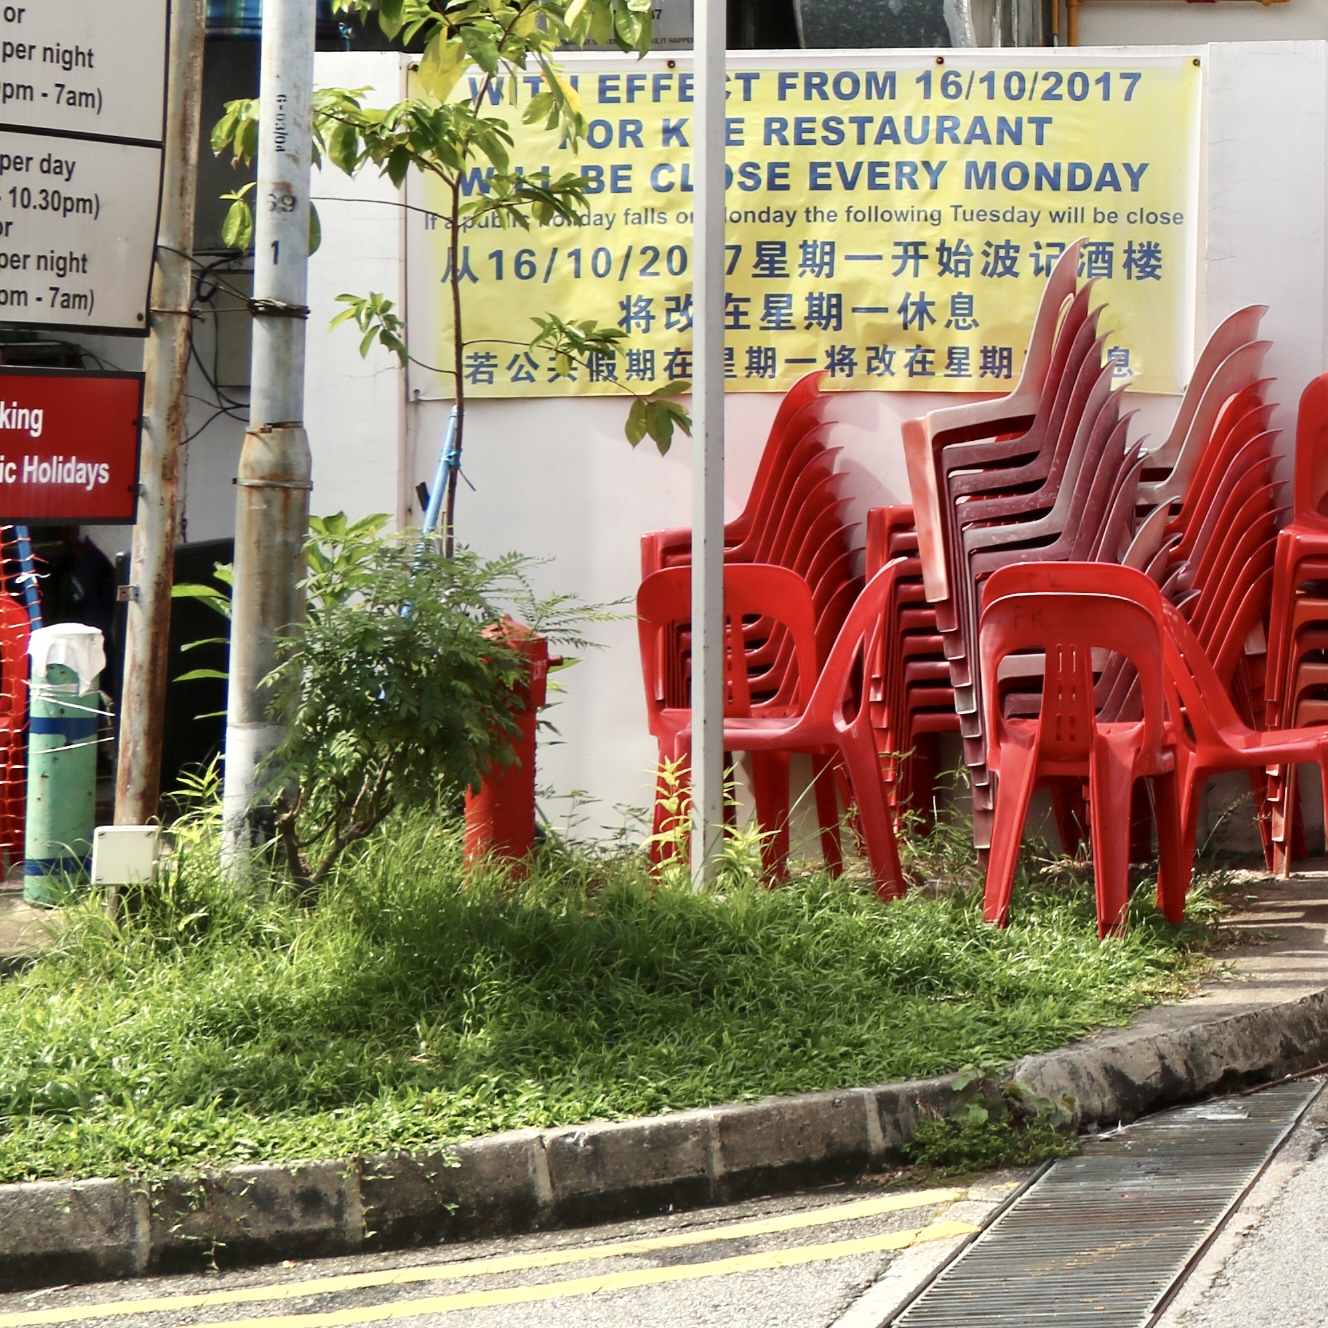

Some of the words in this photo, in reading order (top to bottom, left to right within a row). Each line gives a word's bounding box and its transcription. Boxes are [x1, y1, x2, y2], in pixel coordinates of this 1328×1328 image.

[3, 6, 26, 24] or
[2, 40, 36, 63] per
[42, 43, 95, 71] night
[55, 83, 103, 115] 7am)
[598, 72, 760, 104] EFFET
[777, 70, 897, 102] FROM
[915, 70, 1142, 102] 16/10/2017
[558, 119, 643, 150] OR
[661, 117, 745, 148] KE
[763, 115, 1053, 147] RESTAURANT
[0, 153, 33, 175] per
[39, 153, 76, 182] day
[581, 164, 633, 194] BE
[808, 160, 948, 191] EVERY
[964, 160, 1149, 192] MONDAY
[8, 186, 100, 221] 10.30pm)
[623, 207, 671, 227] falls
[725, 205, 797, 228] onday
[804, 206, 838, 223] the
[845, 205, 942, 227] following
[950, 204, 1041, 228] Tuesday
[1049, 206, 1085, 224] will
[1093, 207, 1119, 224] be
[1126, 207, 1184, 225] close
[36, 250, 88, 278] night
[48, 286, 95, 317] 7am)
[22, 455, 110, 491] Holidays
